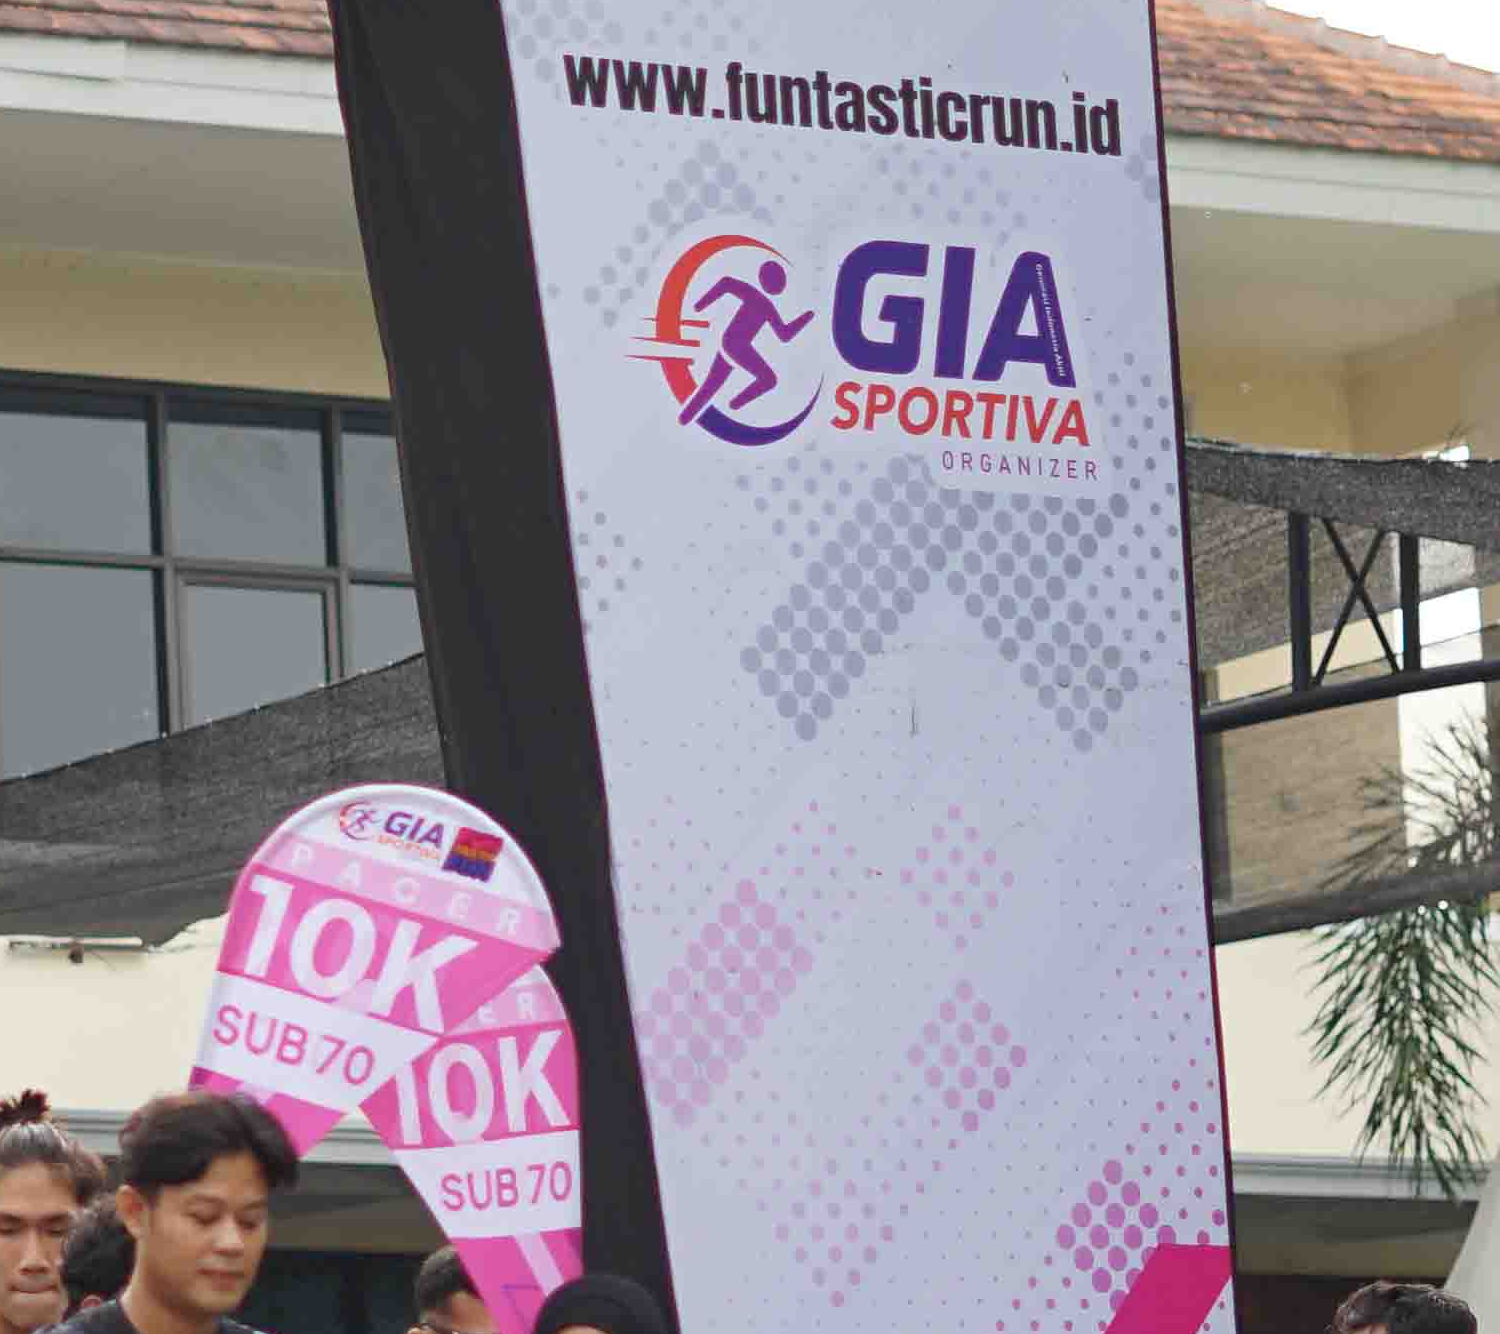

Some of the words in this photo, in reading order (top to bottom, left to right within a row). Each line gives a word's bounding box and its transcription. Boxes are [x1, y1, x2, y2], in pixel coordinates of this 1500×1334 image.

[563, 53, 1121, 157] www.funtasticrun.id
[831, 239, 1076, 389] GIA
[830, 380, 1091, 447] SPORTIVA
[941, 450, 1100, 481] ORGANIZER
[384, 810, 445, 849] GIA
[243, 875, 479, 1033] 10K
[213, 1004, 309, 1065] SUB
[314, 1033, 376, 1085] 70
[396, 1028, 571, 1145] 10K
[441, 1167, 519, 1211] SUB
[526, 1161, 573, 1205] 70
